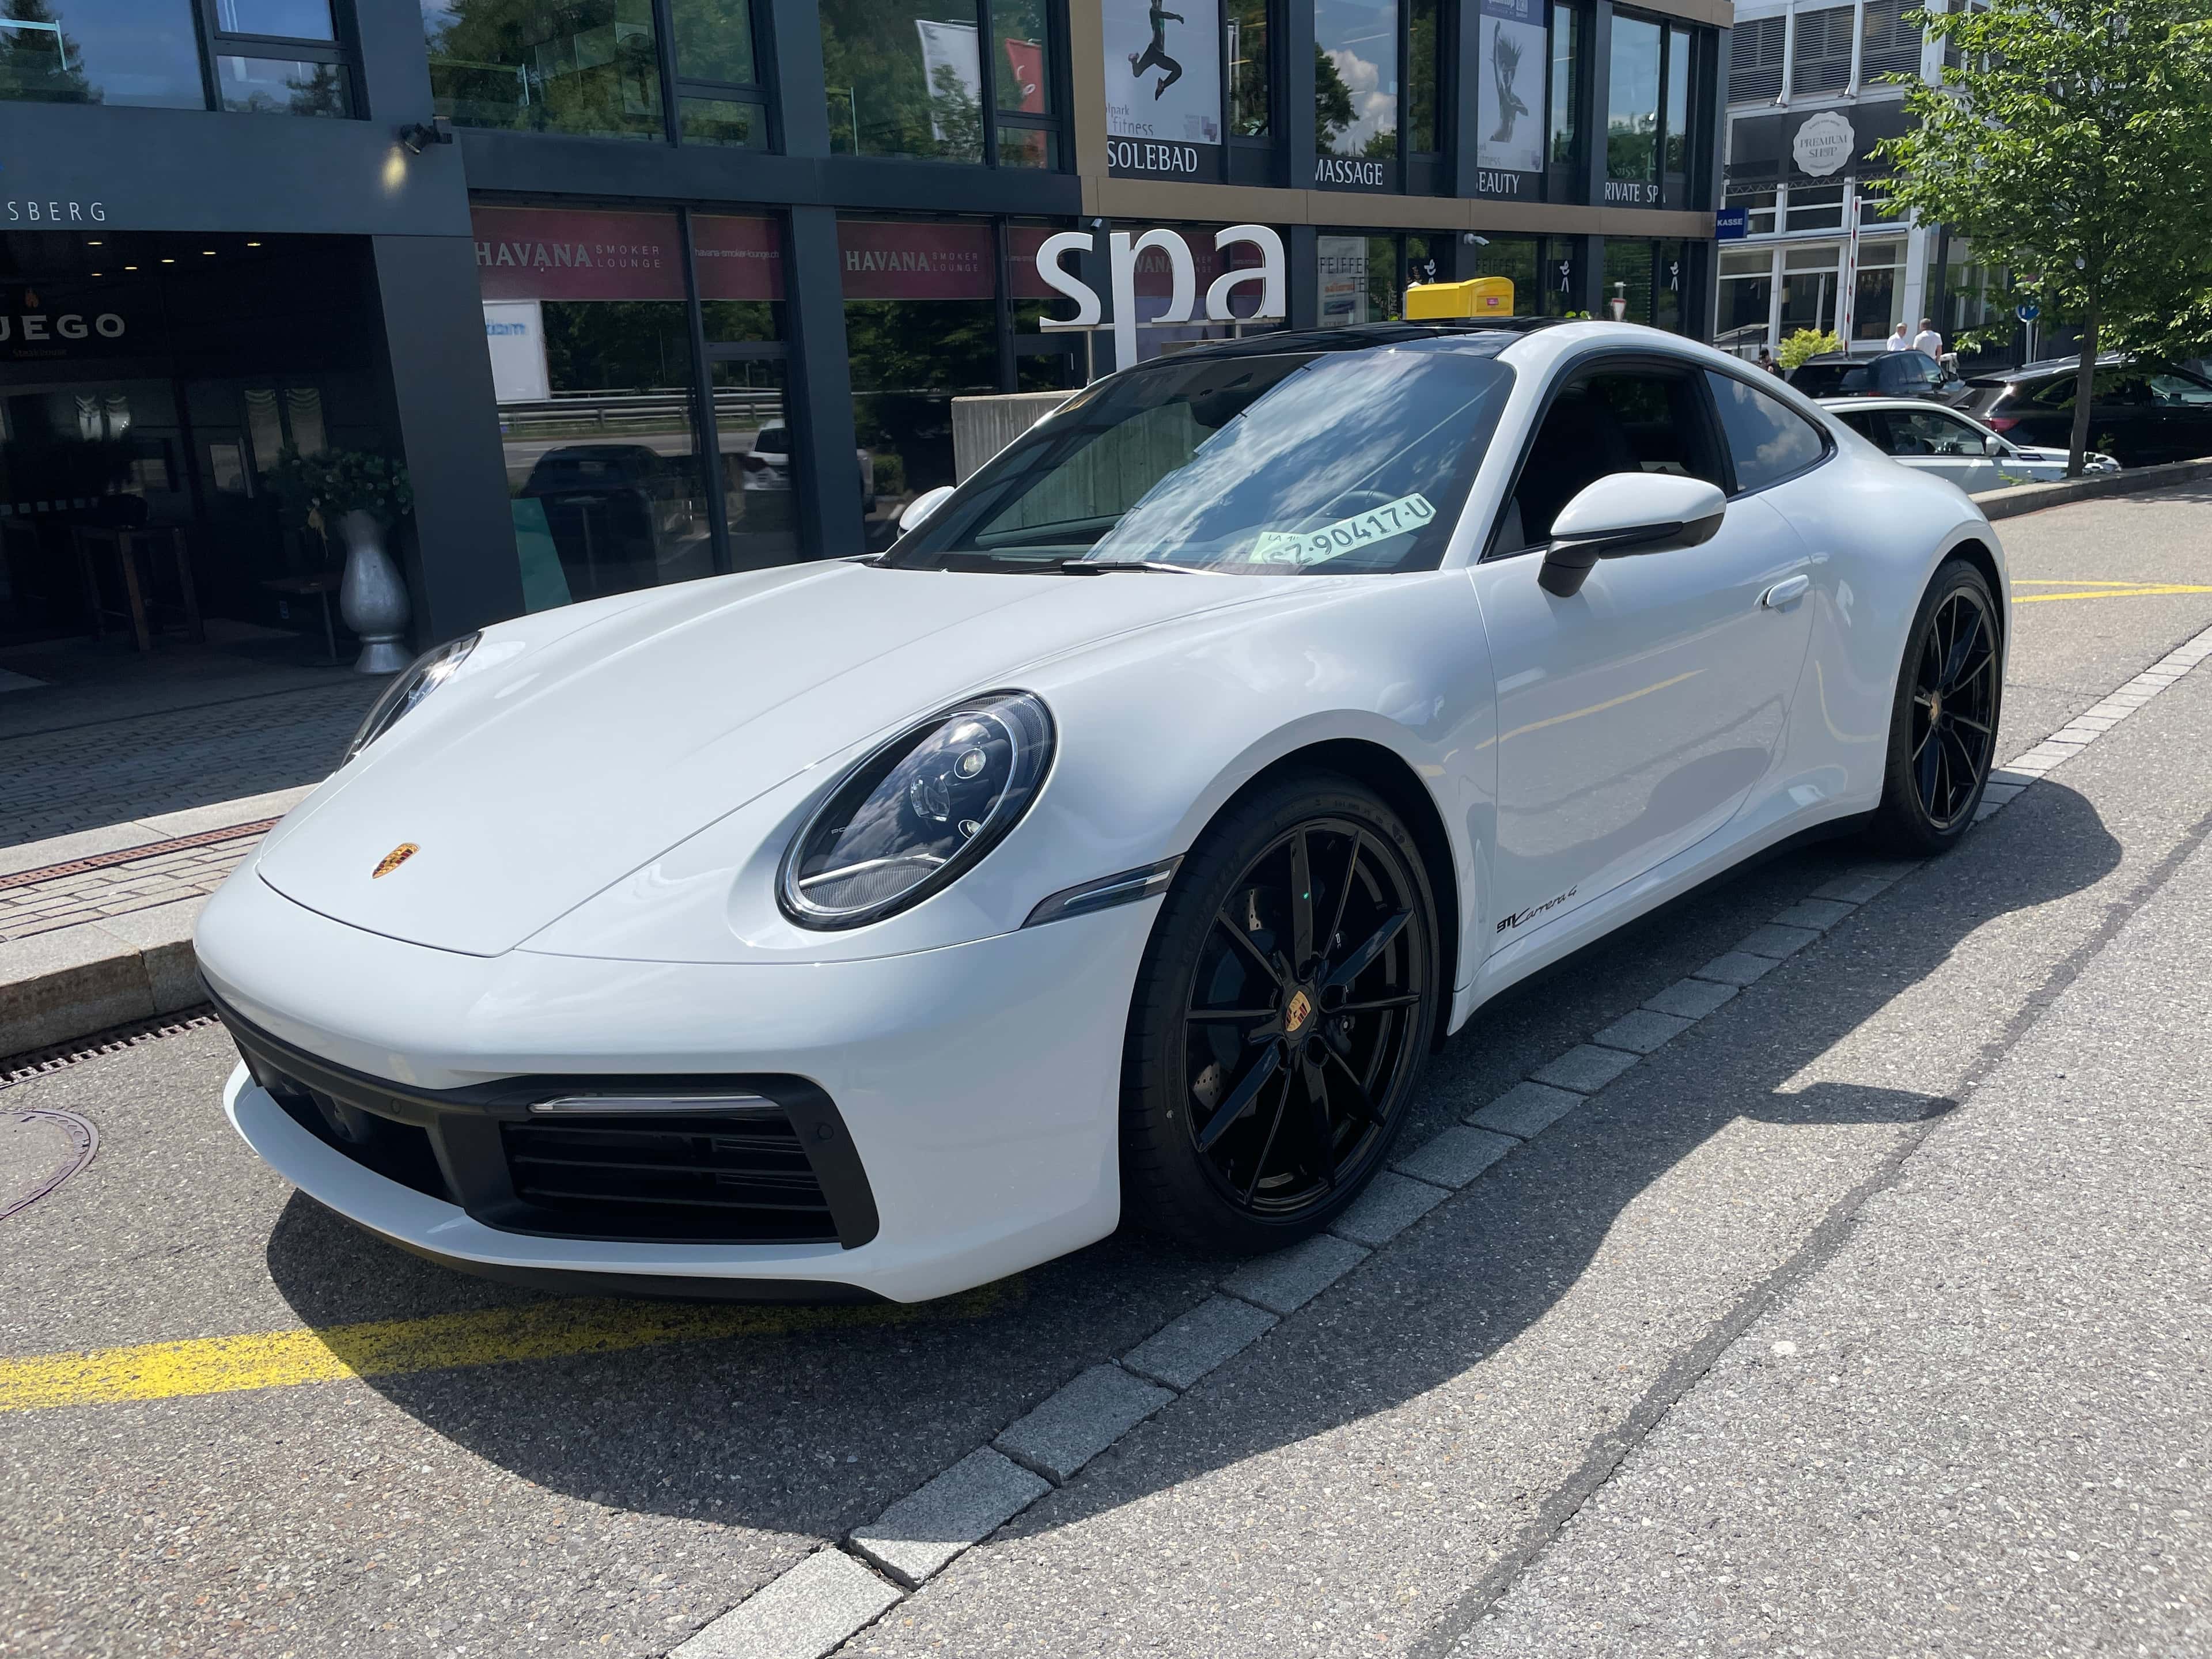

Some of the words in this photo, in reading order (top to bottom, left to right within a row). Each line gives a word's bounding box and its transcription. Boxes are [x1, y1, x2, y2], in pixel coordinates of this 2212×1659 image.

[1112, 116, 1153, 136] fitness
[1800, 134, 1847, 148] PREMIUM
[1107, 141, 1198, 173] SOLEBAD
[1809, 147, 1838, 158] SHOP
[1315, 158, 1383, 185] MASSAGE
[1476, 171, 1520, 194] EAUTY
[1605, 181, 1641, 202] RIVATE
[7, 201, 105, 221] SBERG
[1717, 218, 1743, 226] KASSE
[474, 241, 593, 268] HAVANA
[596, 244, 660, 256] SMOKER
[597, 258, 662, 268] LOUNGE
[845, 250, 930, 272] HAVANA
[932, 252, 978, 260] SMOKER
[933, 263, 978, 272] LOUNGE
[1036, 224, 1286, 372] spa
[1512, 893, 1567, 929] Carrera
[1567, 884, 1578, 897] 4
